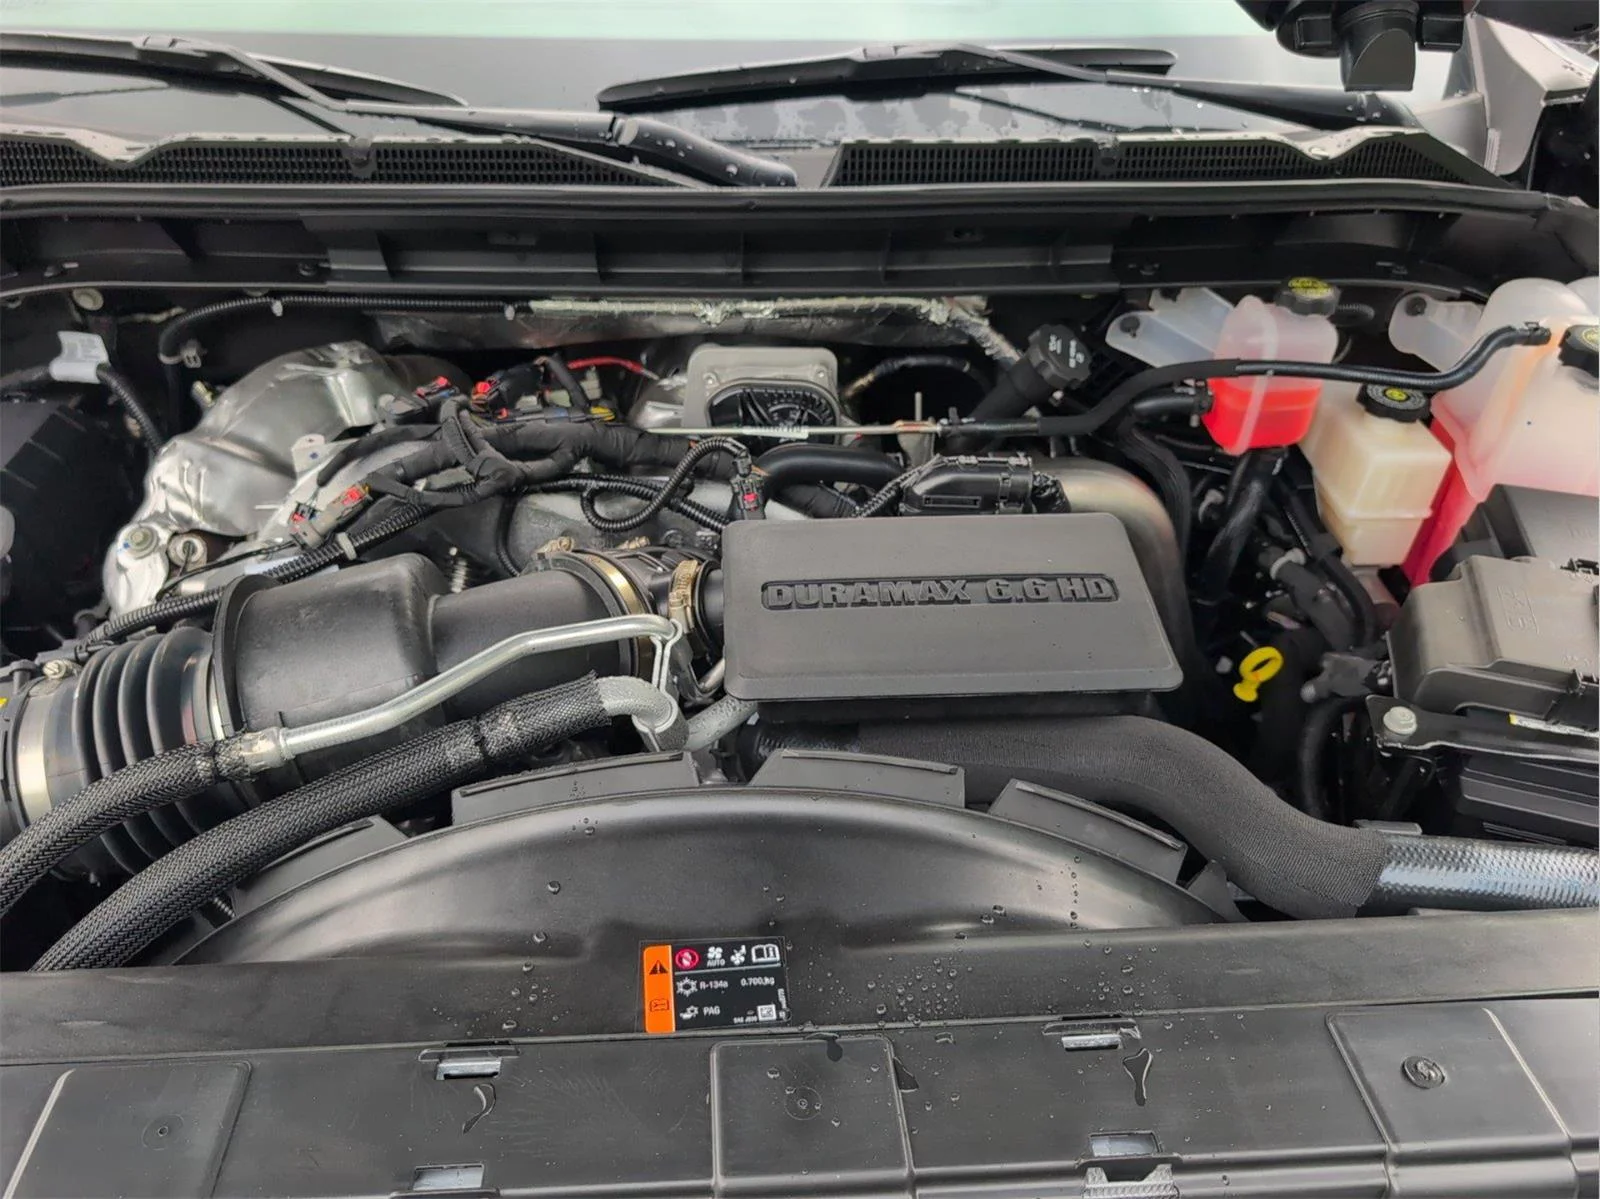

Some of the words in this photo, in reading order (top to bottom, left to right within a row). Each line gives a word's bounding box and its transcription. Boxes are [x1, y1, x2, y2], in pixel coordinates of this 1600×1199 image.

[766, 579, 970, 608] DURAMAX
[985, 577, 1050, 604] 6.6
[1056, 575, 1116, 602] HD
[707, 958, 726, 967] AUTO
[703, 1005, 721, 1016] PAG
